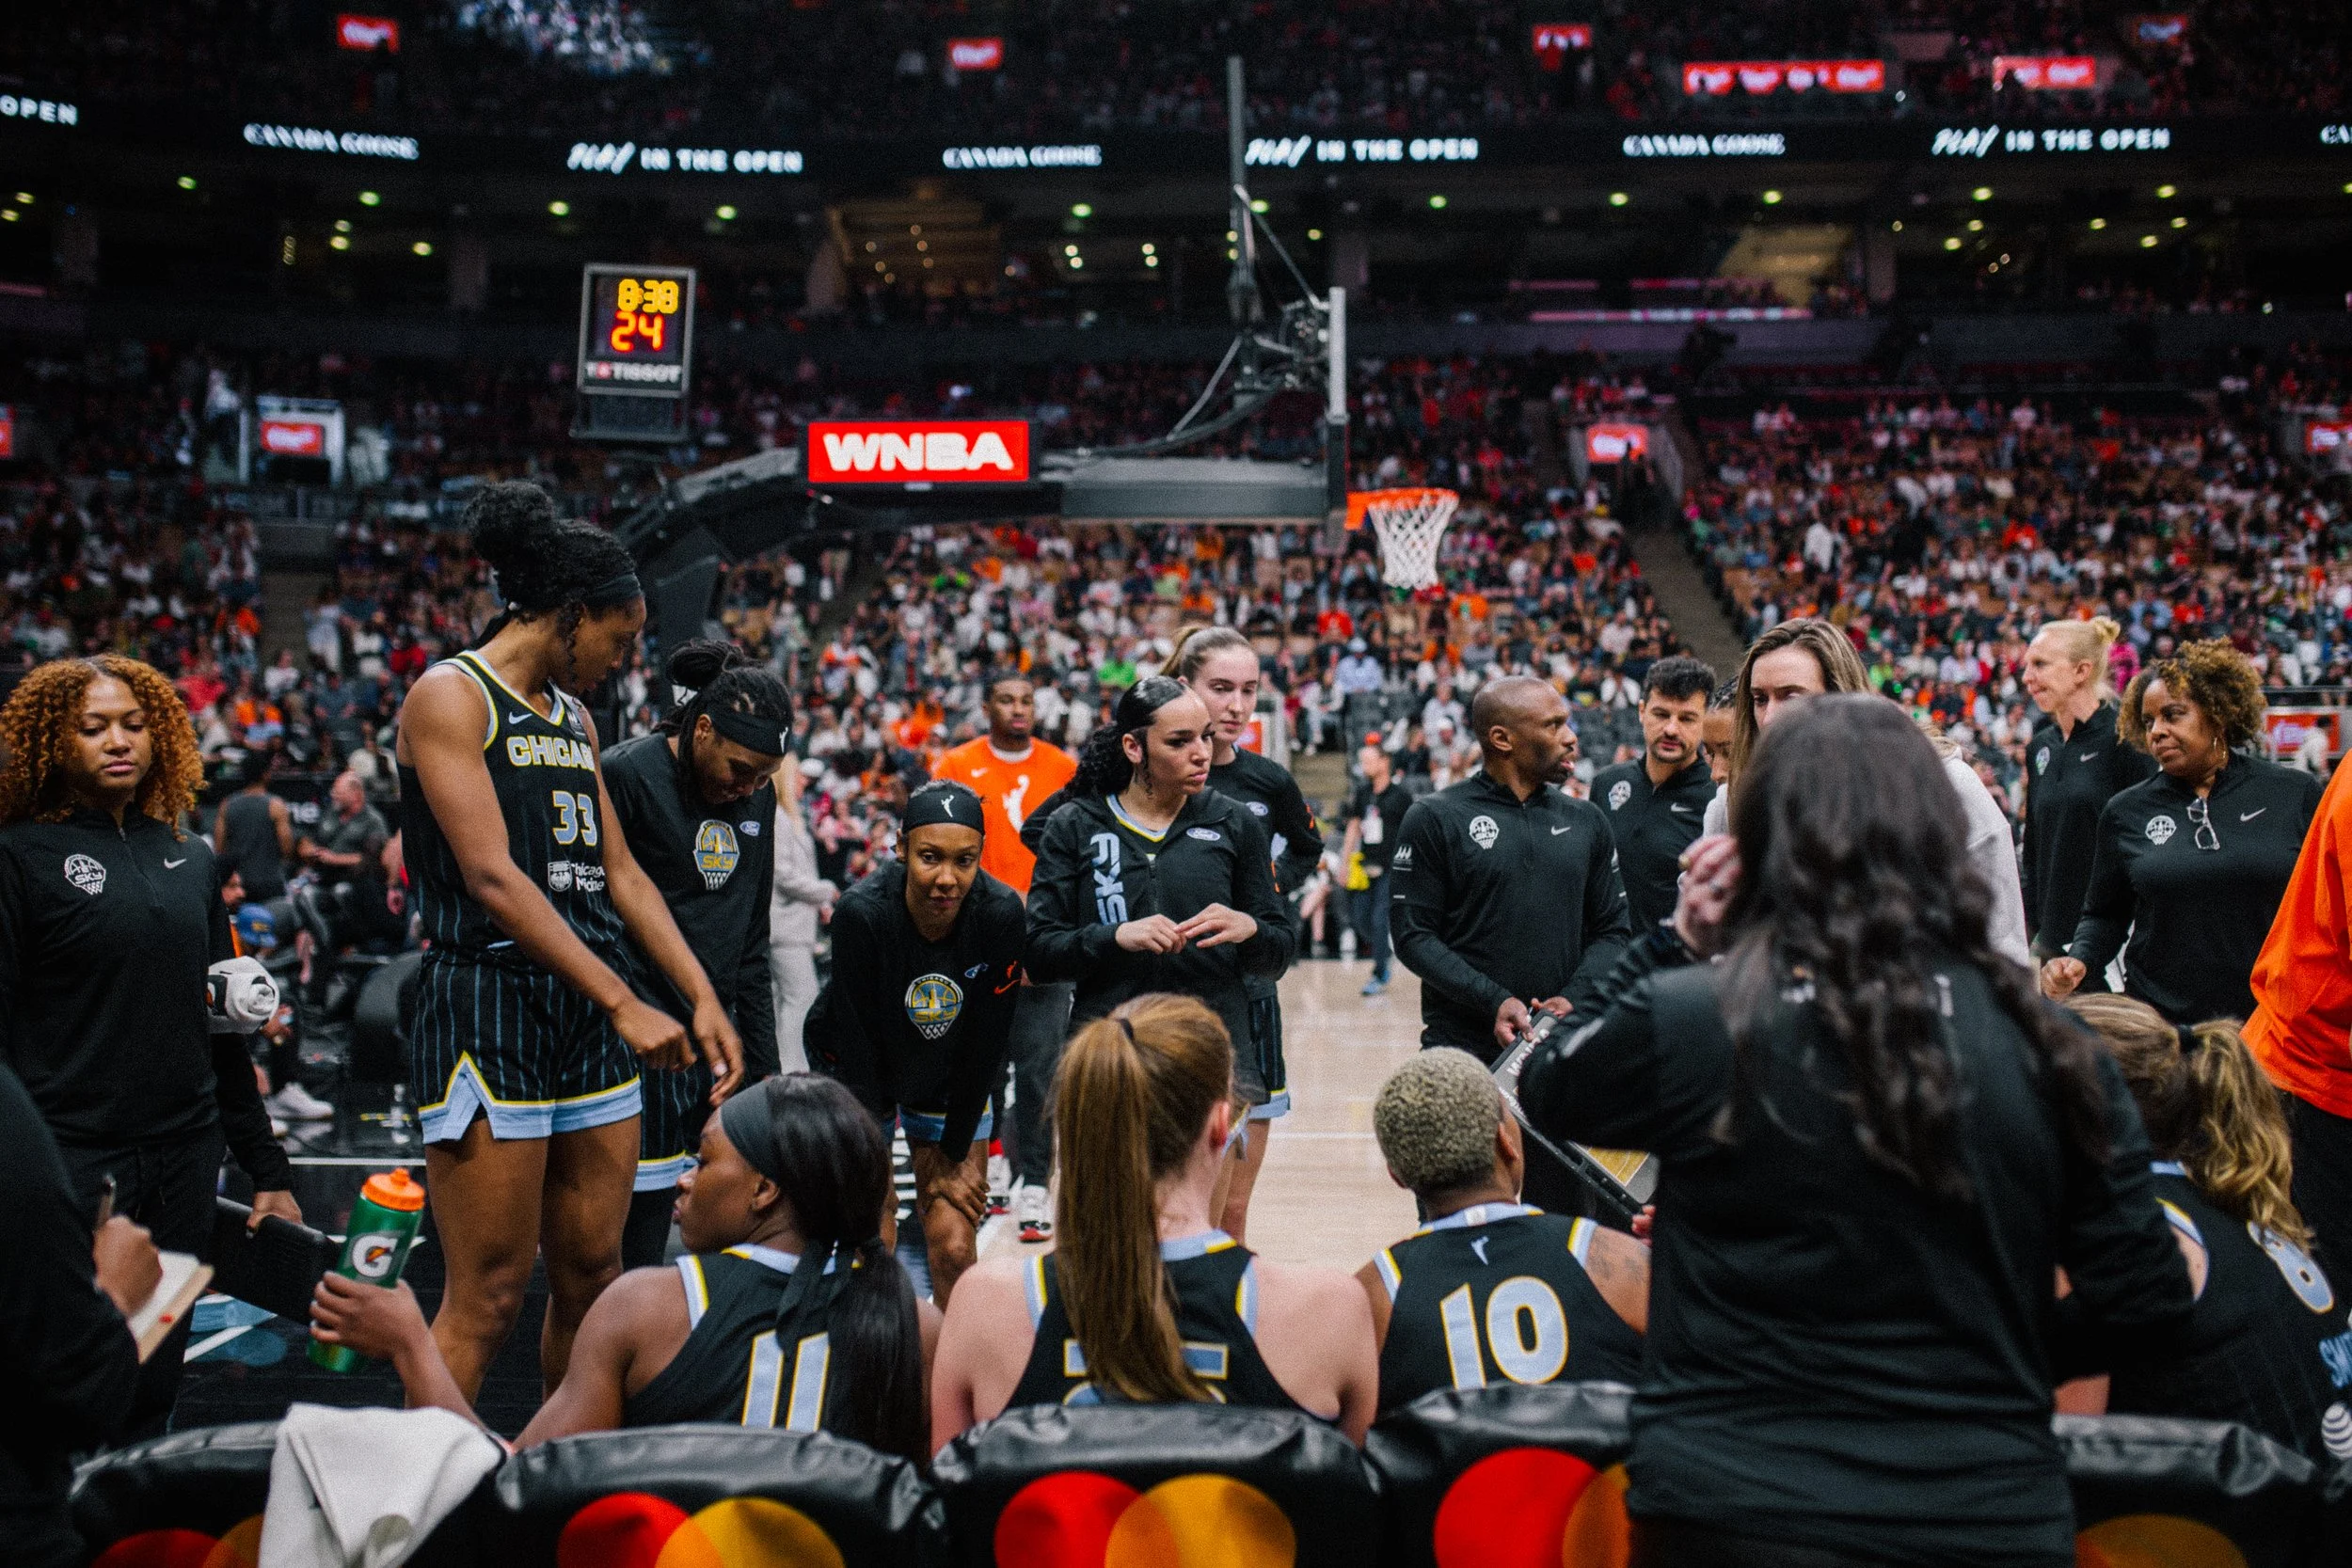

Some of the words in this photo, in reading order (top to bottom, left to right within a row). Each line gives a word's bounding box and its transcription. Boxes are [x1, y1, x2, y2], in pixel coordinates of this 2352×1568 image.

[0, 95, 77, 125] OPEN
[1317, 139, 1346, 162] IN
[1352, 138, 1404, 162] THE
[1409, 137, 1479, 161] OPEN
[2005, 130, 2035, 152] IN
[2042, 129, 2093, 151] THE
[2100, 128, 2170, 150] OPEN
[640, 148, 671, 170] IN
[675, 148, 728, 172] THE
[733, 150, 803, 173] OPEN
[610, 309, 664, 354] 24
[822, 432, 1014, 472] WNBA
[552, 790, 597, 847] 33
[74, 871, 103, 885] SKY
[701, 854, 734, 870] SKY
[352, 1234, 398, 1277] G
[1439, 1275, 1569, 1391] 10
[739, 1327, 832, 1433] 11
